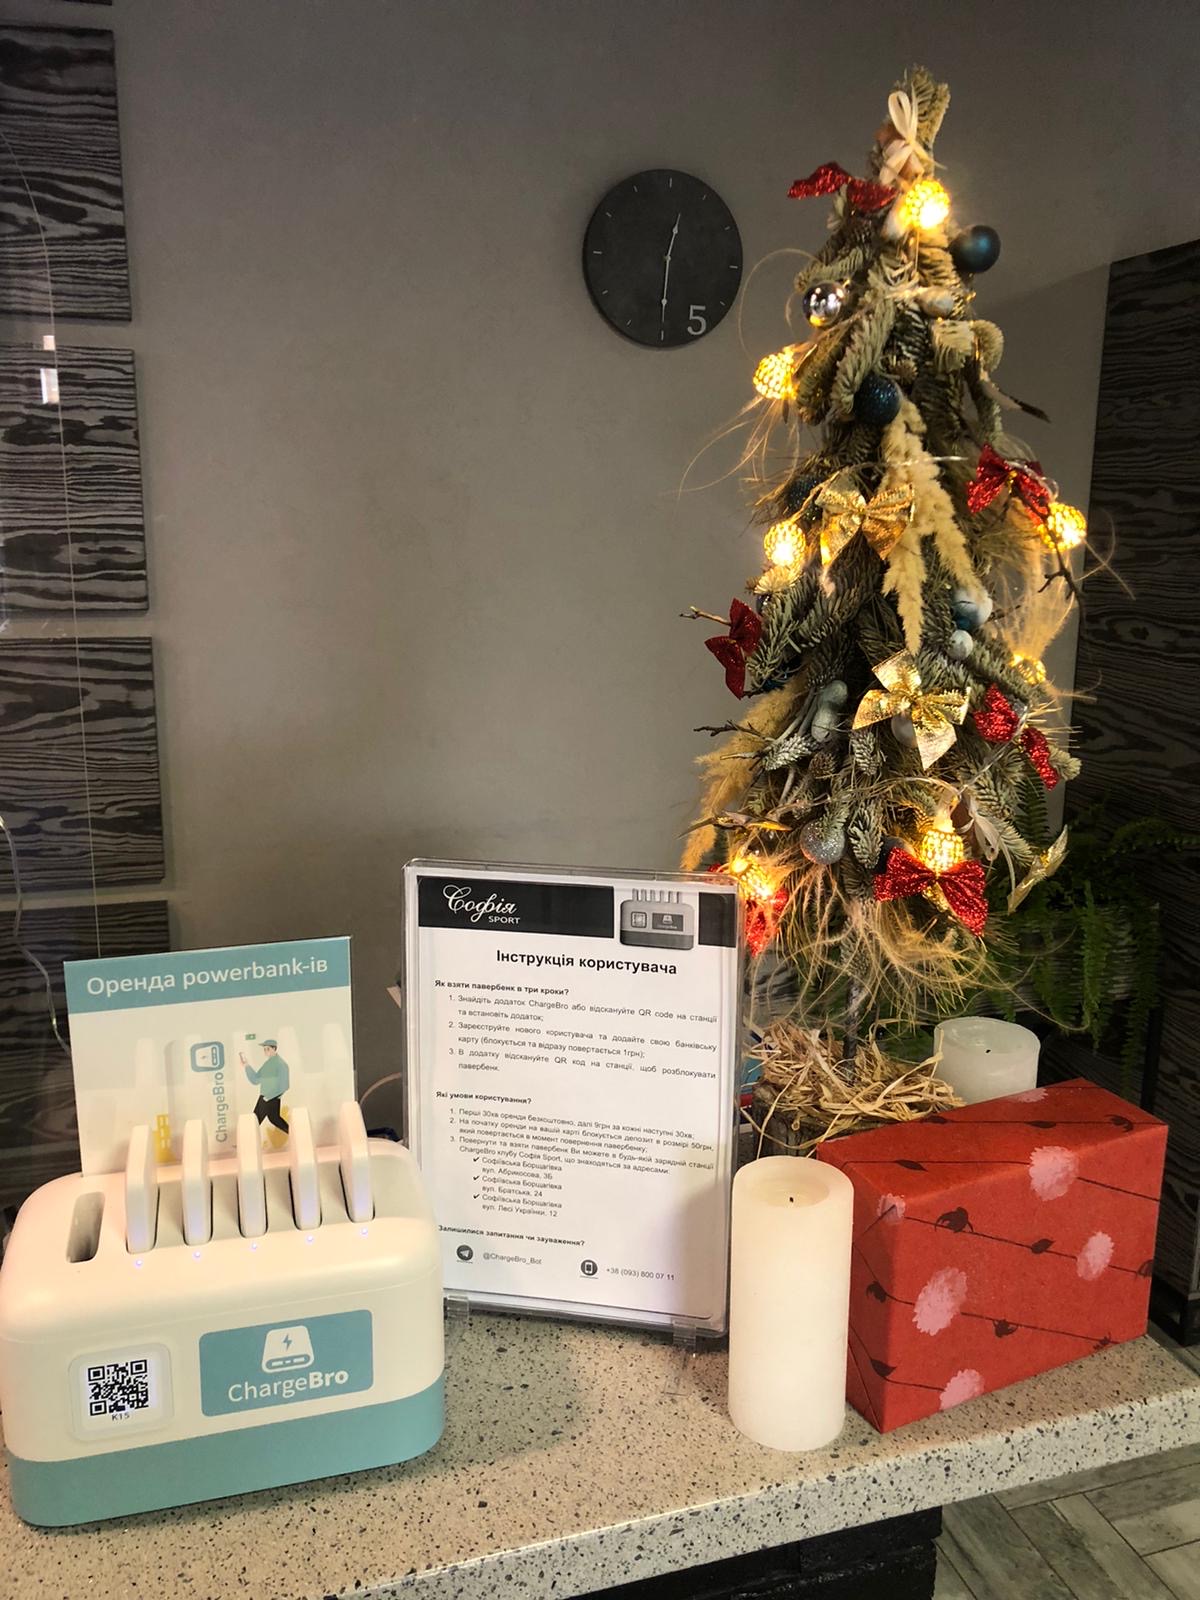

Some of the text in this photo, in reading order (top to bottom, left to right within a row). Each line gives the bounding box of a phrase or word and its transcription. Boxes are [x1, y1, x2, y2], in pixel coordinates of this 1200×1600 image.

[687, 304, 707, 335] 5
[443, 884, 517, 923] Софія
[488, 915, 521, 924] SPORT
[496, 949, 677, 974] Інструкція користувача
[87, 956, 328, 998] Оренда powerbank-ів
[472, 983, 515, 992] павербенк
[540, 988, 569, 996] кроки?
[458, 995, 491, 1004] Знайдіть
[494, 998, 525, 1006] додаток
[529, 1000, 568, 1010] ChargeBro
[590, 1005, 635, 1015] відскануйте
[655, 1011, 673, 1019] code
[690, 1014, 717, 1023] станції
[469, 1010, 508, 1018] встановіть
[511, 1013, 543, 1022] додаток;
[458, 1022, 510, 1032] Зареєструйте
[546, 1030, 593, 1039] користувача
[612, 1035, 645, 1044] додайте
[675, 1040, 717, 1052] банківську
[458, 1037, 479, 1045] карту
[481, 1036, 526, 1047] (блокується
[538, 1042, 566, 1051] відразу
[568, 1045, 621, 1055] повертається
[624, 1049, 645, 1058] 1грн);
[458, 1063, 500, 1071] павербенк.
[469, 1050, 500, 1059] додатку
[505, 1052, 549, 1062] відскануйте
[640, 1065, 657, 1073] щоб
[662, 1067, 716, 1079] розблокувати
[212, 1071, 228, 1143] ChargeBro
[475, 1094, 532, 1104] користування?
[471, 1120, 498, 1128] початку
[501, 1123, 526, 1131] оренди
[582, 1130, 622, 1140] блокується
[624, 1135, 653, 1143] депозит
[663, 1140, 688, 1148] розмірі
[482, 1110, 499, 1118] 30хв
[500, 1113, 526, 1121] оренди
[594, 1121, 610, 1130] 9грн
[622, 1125, 641, 1133] кожні
[643, 1128, 673, 1137] наступні
[477, 1129, 524, 1139] повертається
[560, 1137, 602, 1147] повернення
[459, 1136, 497, 1146] Повернути
[531, 1143, 568, 1153] павербенк
[583, 1150, 609, 1158] можете
[619, 1152, 652, 1162] будь-якій
[655, 1158, 686, 1166] зарядній
[689, 1162, 714, 1170] станції
[460, 1146, 496, 1155] ChargeBro
[498, 1150, 517, 1158] клубу
[519, 1151, 540, 1160] Софія
[543, 1154, 563, 1163] Sport,
[577, 1159, 621, 1169] знаходяться
[482, 1157, 562, 1171] Софіївська Борщагівка
[482, 1175, 562, 1190] Софіївська Борщагівка
[482, 1194, 562, 1208] Софіївська Борщагівка
[438, 1225, 484, 1235] Залишилися
[486, 1231, 524, 1240] запитання
[537, 1237, 585, 1246] зауваження?
[483, 1252, 542, 1264] @ChargeBro_Bot
[621, 1269, 639, 1278] (093)
[641, 1271, 654, 1279] 800
[228, 1369, 348, 1403] ChargeBro
[112, 1412, 130, 1421] K15
